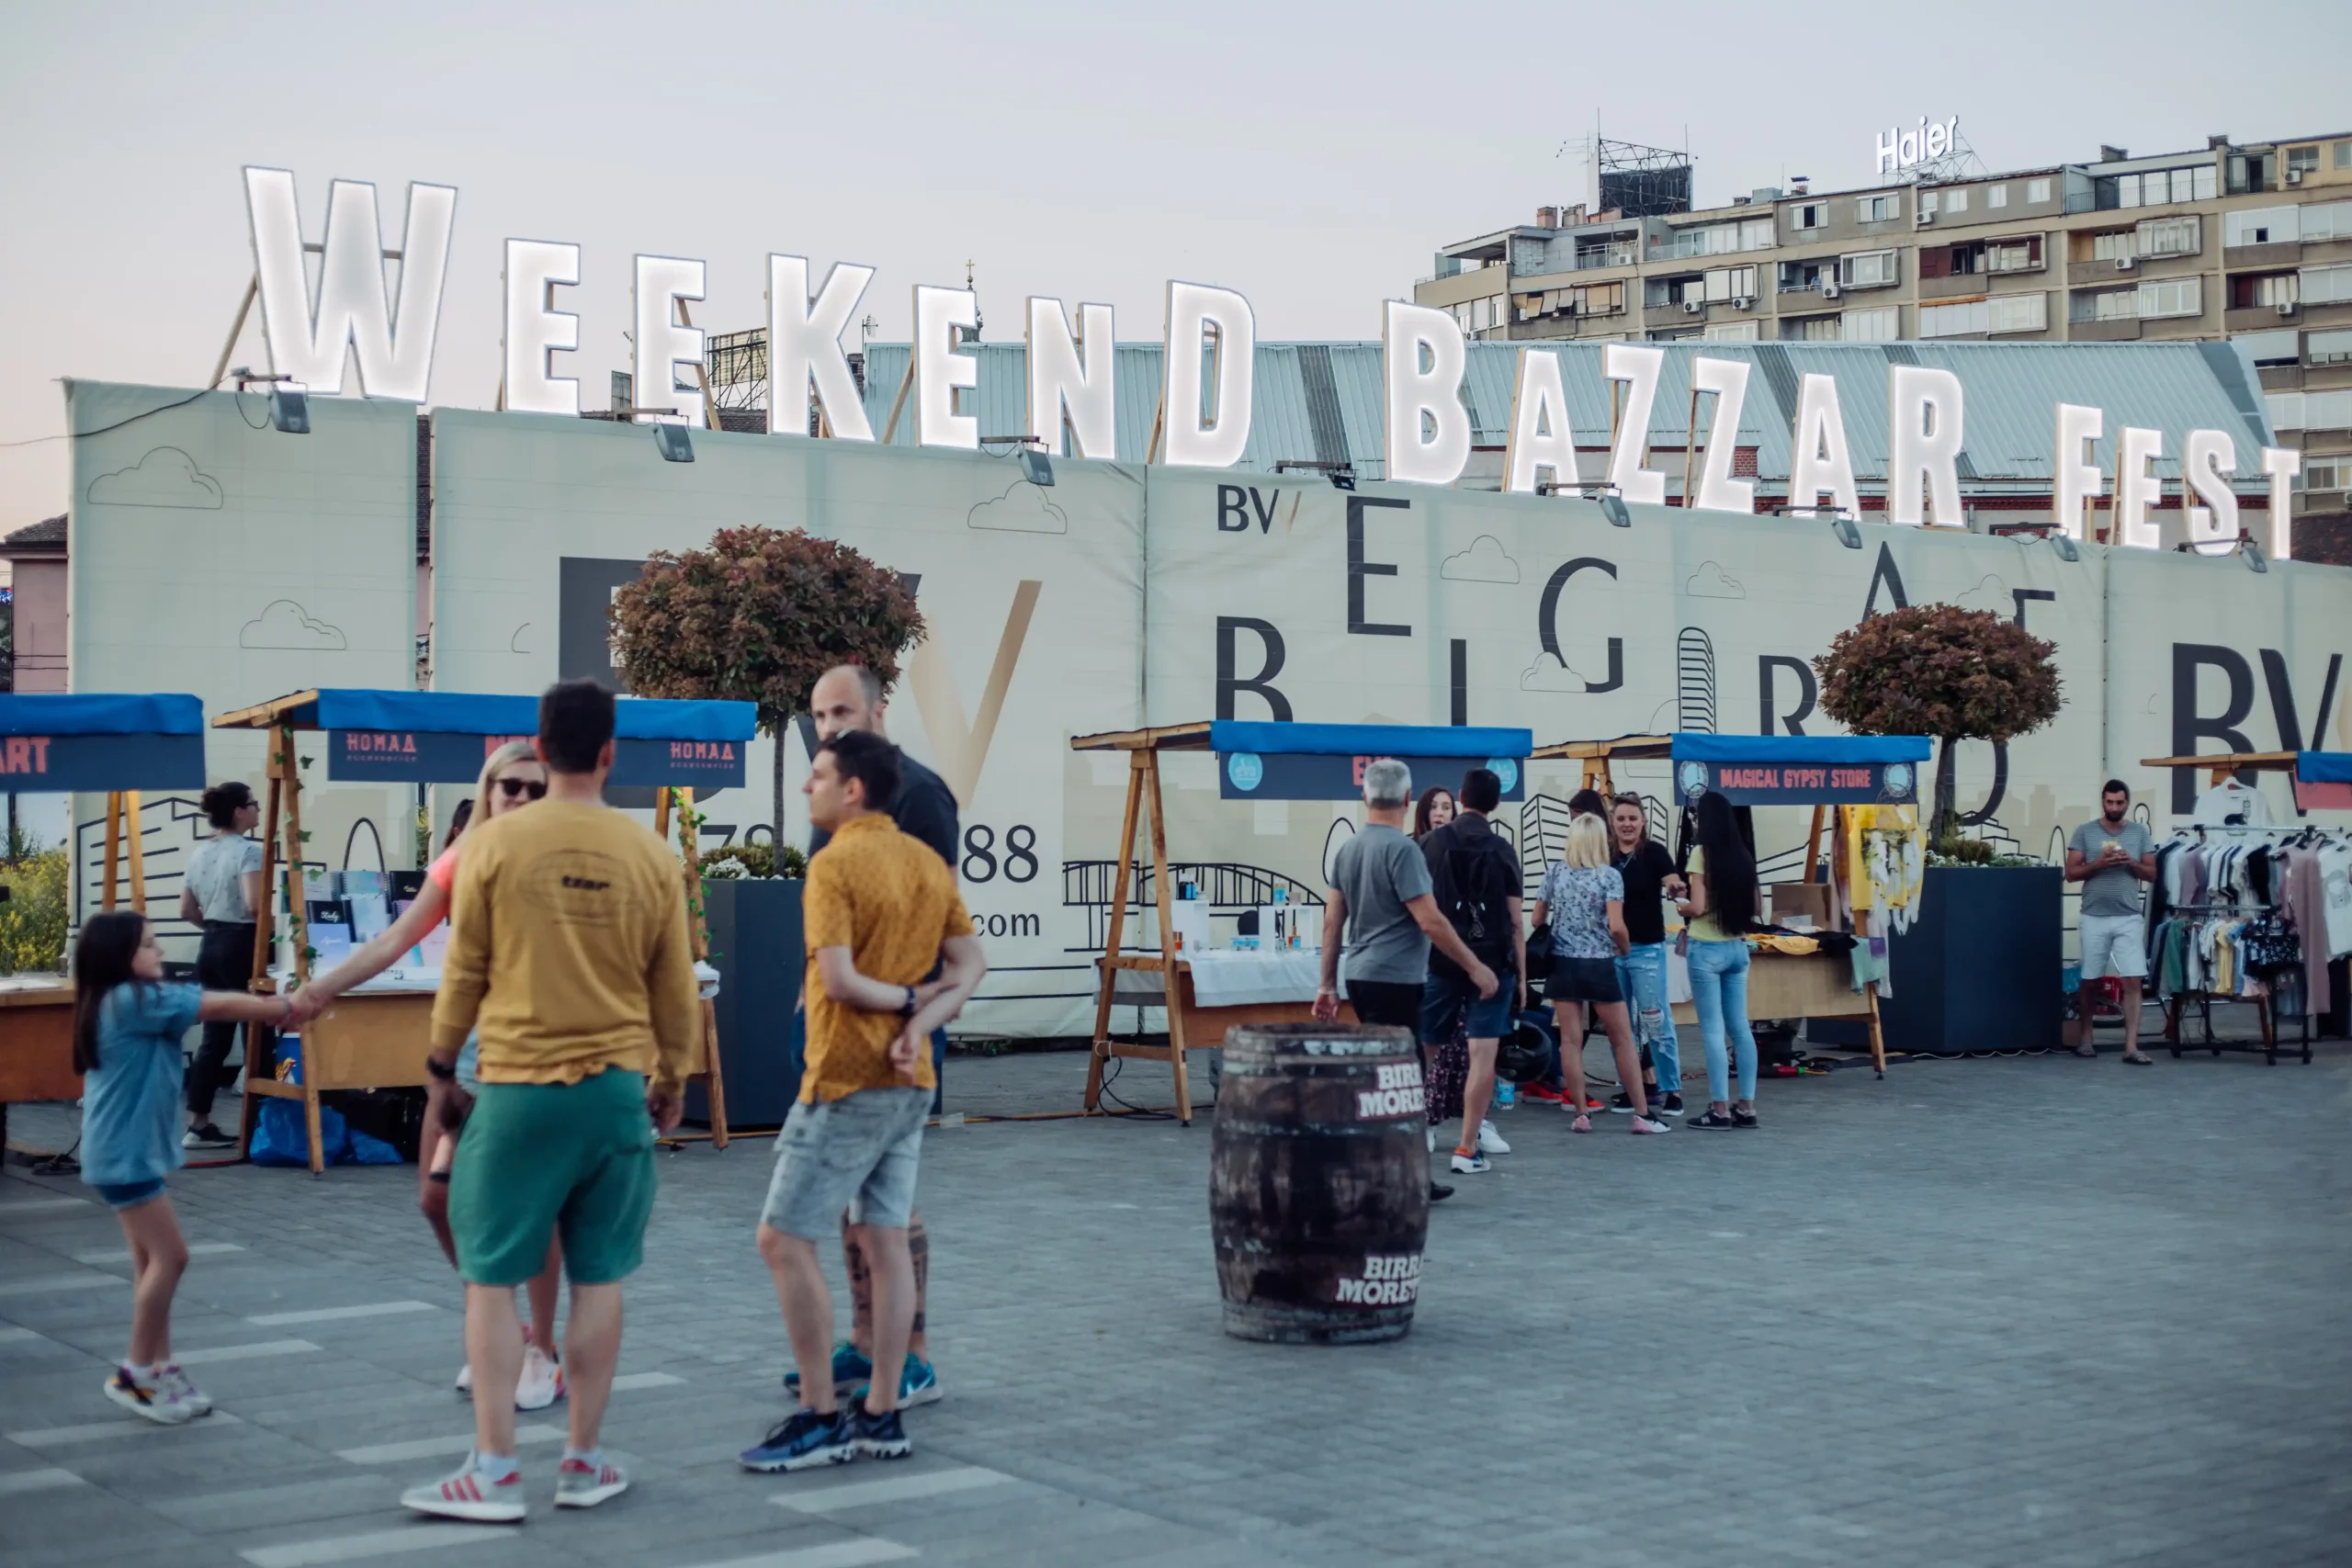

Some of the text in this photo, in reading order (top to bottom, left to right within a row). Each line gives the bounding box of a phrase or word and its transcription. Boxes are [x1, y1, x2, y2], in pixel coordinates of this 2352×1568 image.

[1876, 115, 1958, 175] Haier
[243, 165, 2300, 560] WEEKEND BAZZAR FEST
[0, 736, 51, 773] RT
[1720, 769, 1871, 788] MAGICAL GYPSY STORE
[961, 824, 1039, 883] 88
